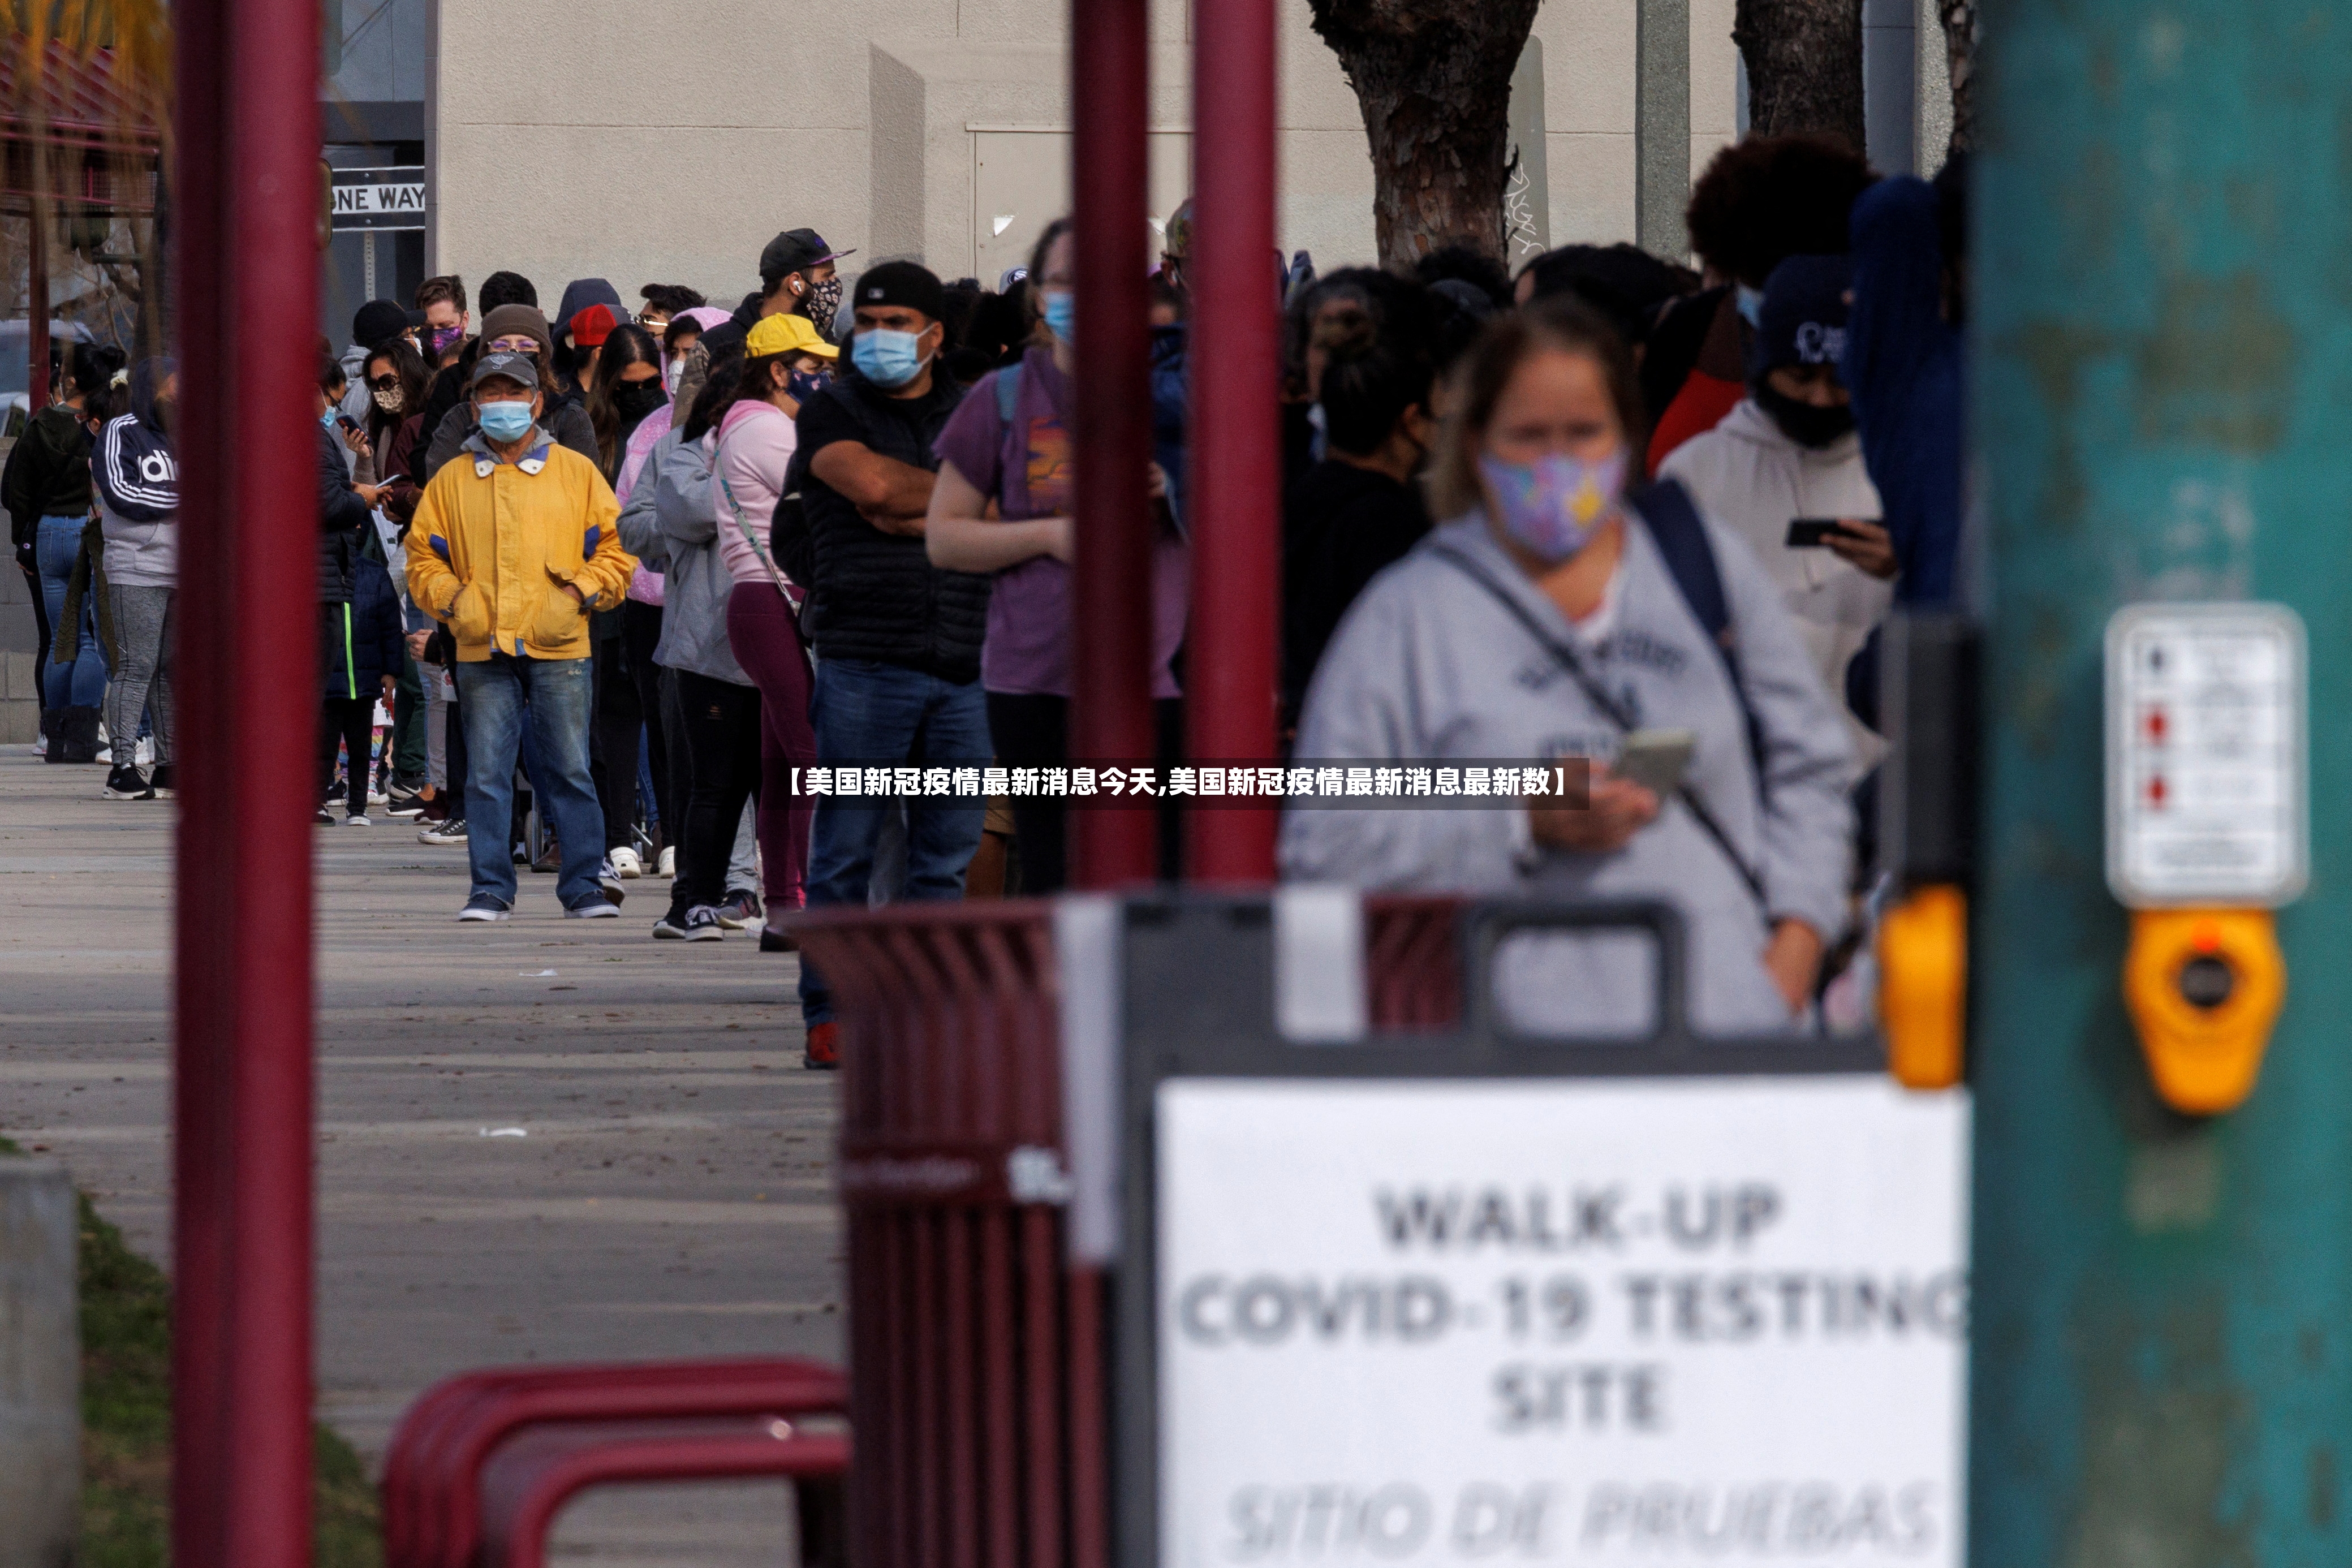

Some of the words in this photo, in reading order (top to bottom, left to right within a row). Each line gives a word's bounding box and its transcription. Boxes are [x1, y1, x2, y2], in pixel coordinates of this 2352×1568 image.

[378, 187, 425, 209] WAY
[1375, 1183, 1783, 1253] WALK-UP
[1179, 1273, 1591, 1346] COVID-19
[1492, 1364, 1661, 1433] SITE
[1229, 1483, 1432, 1560] SITIO
[1452, 1483, 1556, 1554] DE
[1584, 1482, 1938, 1553] PRUEBAS
